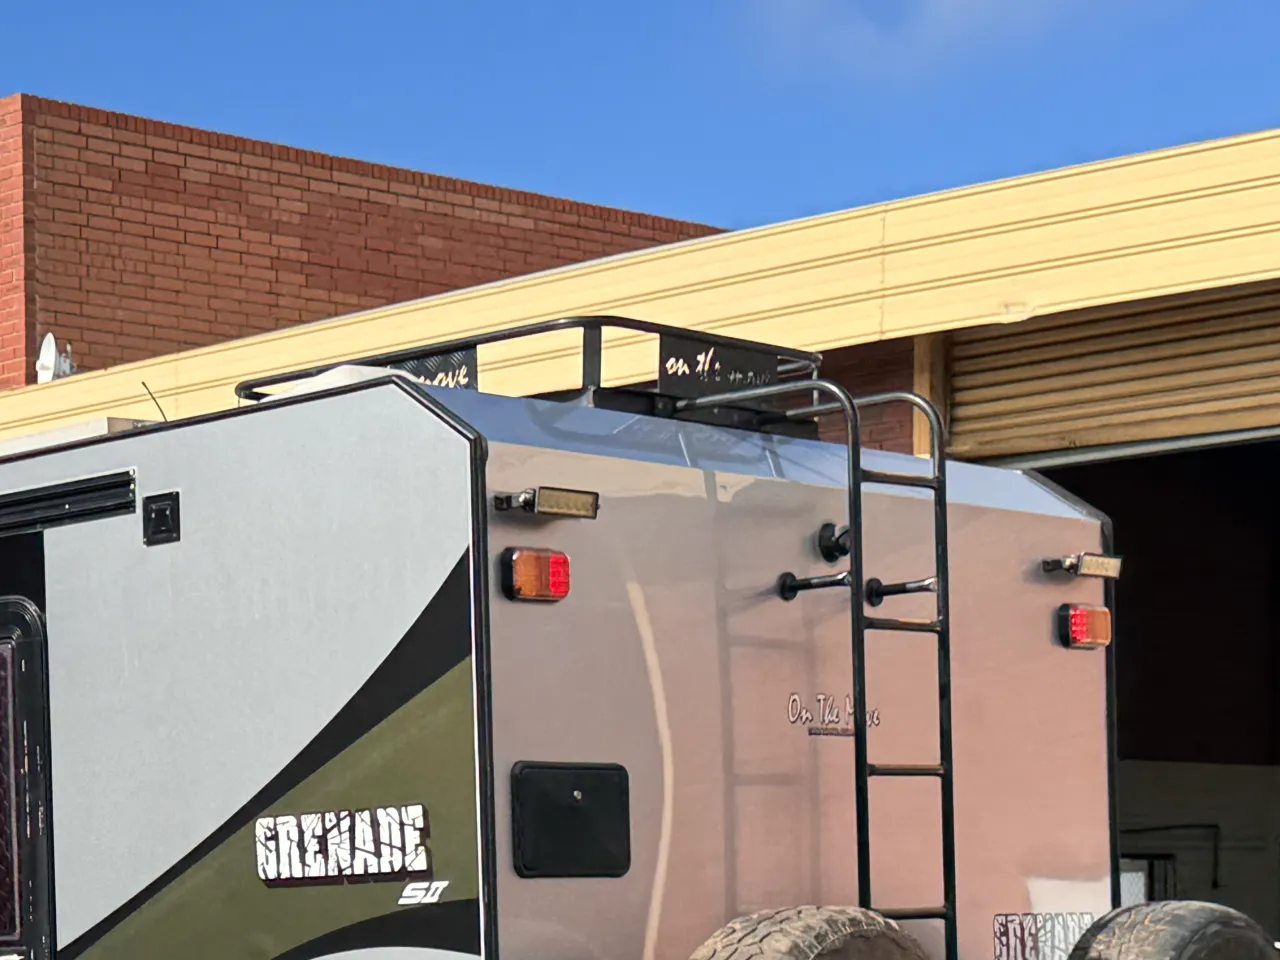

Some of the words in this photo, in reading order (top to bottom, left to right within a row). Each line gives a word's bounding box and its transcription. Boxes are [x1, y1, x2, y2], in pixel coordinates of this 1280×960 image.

[787, 692, 813, 726] On
[816, 692, 840, 726] The
[844, 692, 881, 727] Mve
[255, 803, 430, 884] GRENADE
